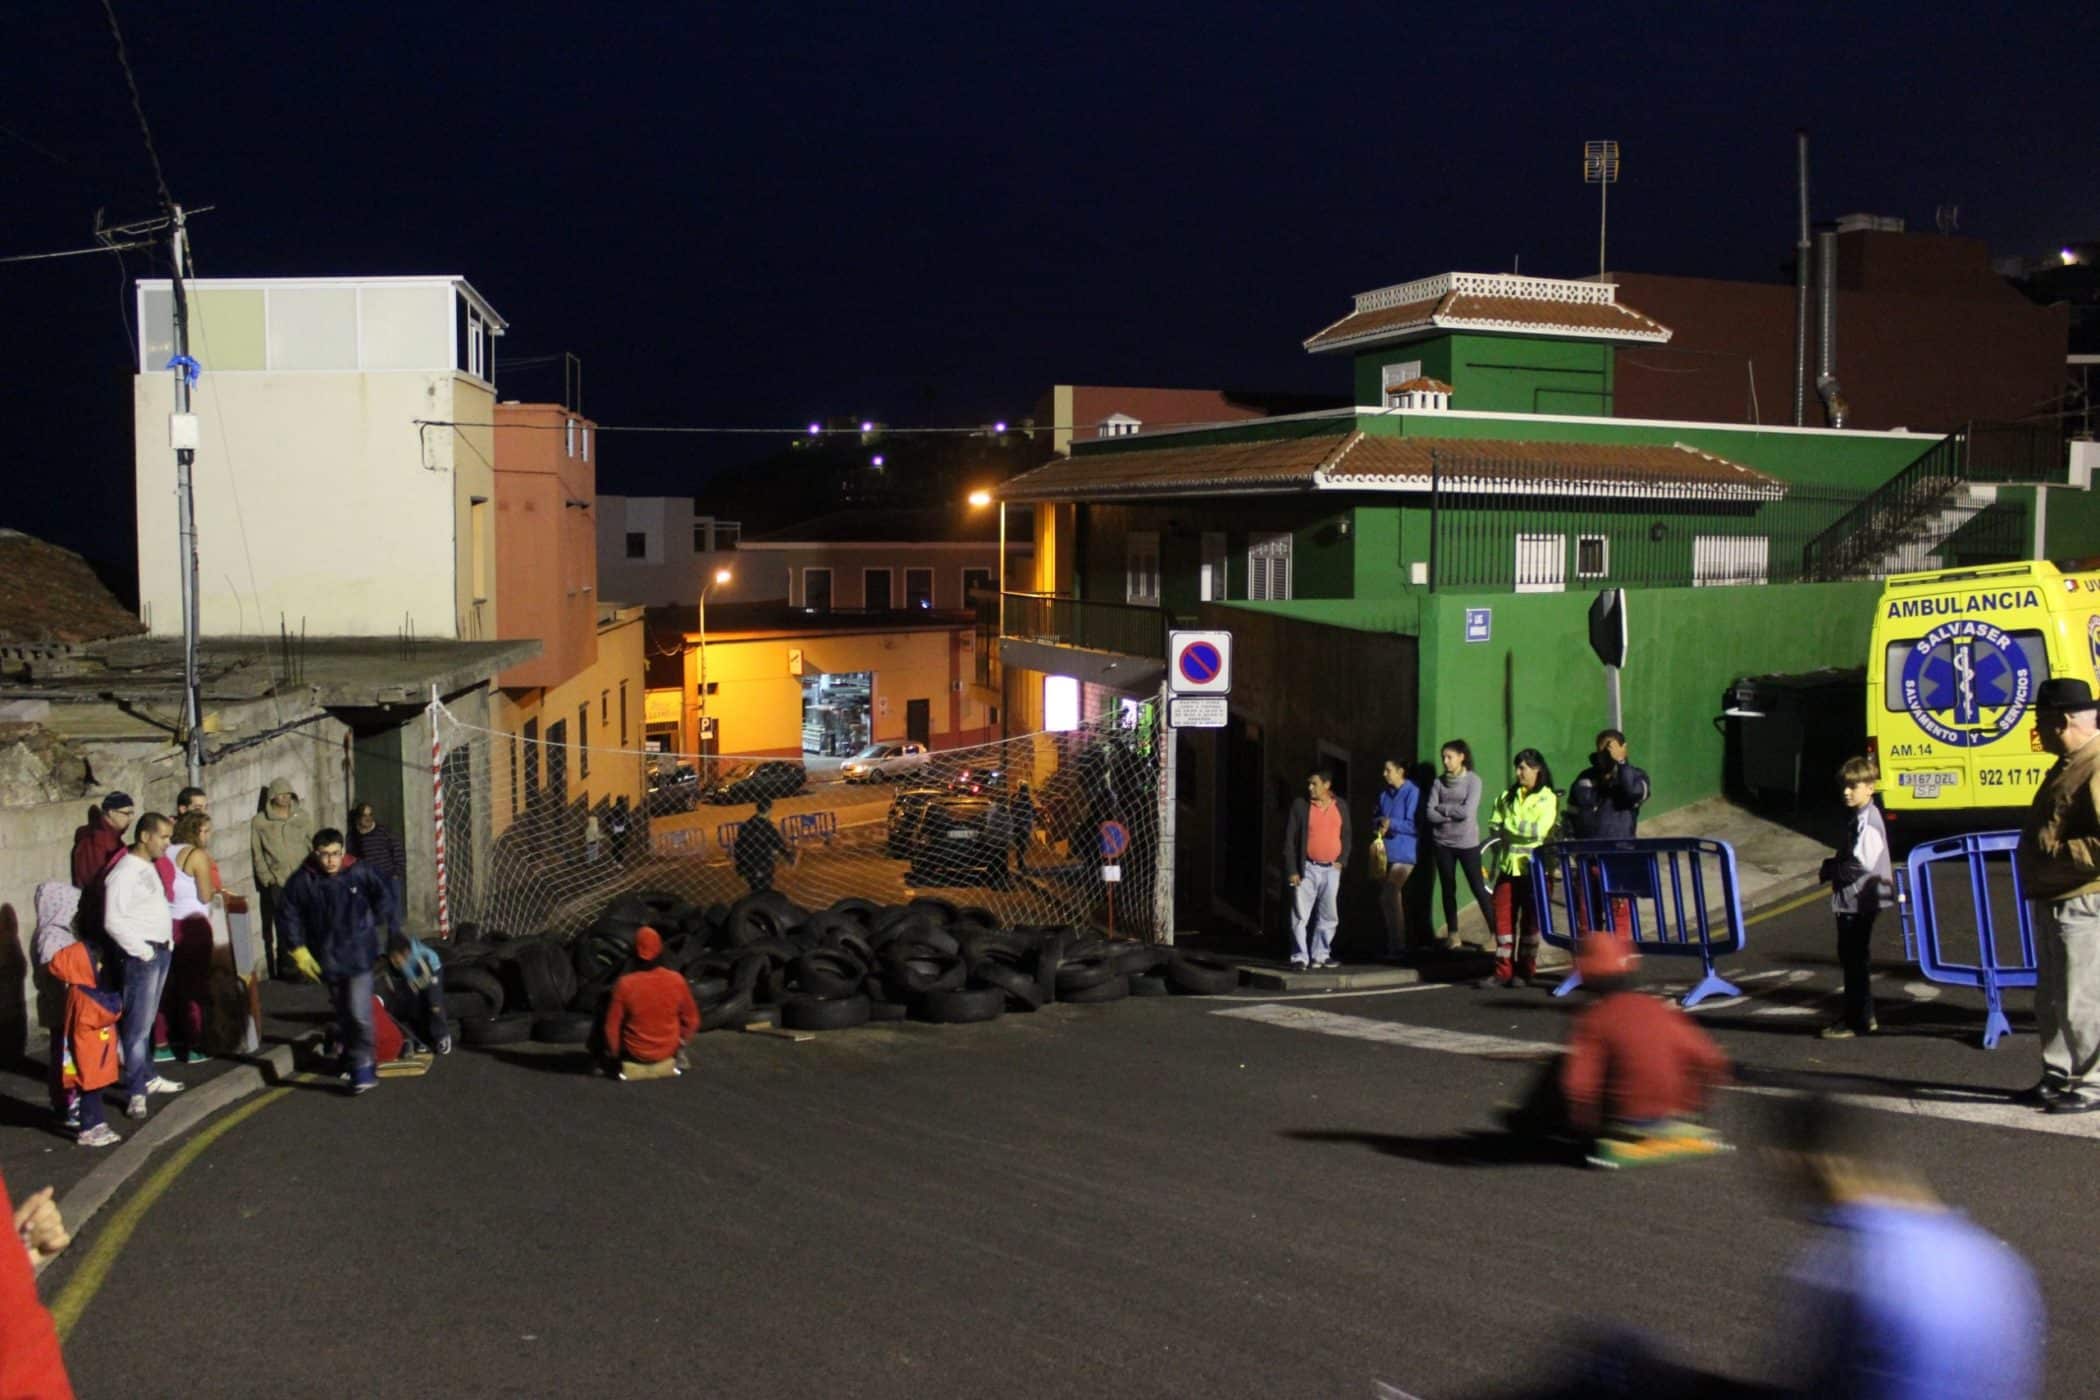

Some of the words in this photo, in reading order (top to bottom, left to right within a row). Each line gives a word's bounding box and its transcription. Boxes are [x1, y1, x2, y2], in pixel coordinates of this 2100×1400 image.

[1887, 591, 2039, 619] AMBULANCIA
[1917, 622, 2011, 654] SALVASER
[1905, 679, 1958, 742] SALVAMENTO
[1970, 733, 1979, 743] Y
[1999, 668, 2028, 731] SERVICIOS
[701, 718, 710, 732] P
[1918, 744, 1932, 756] 14
[1979, 769, 2003, 786] 922
[2008, 769, 2022, 785] 17
[2026, 768, 2040, 785] 17
